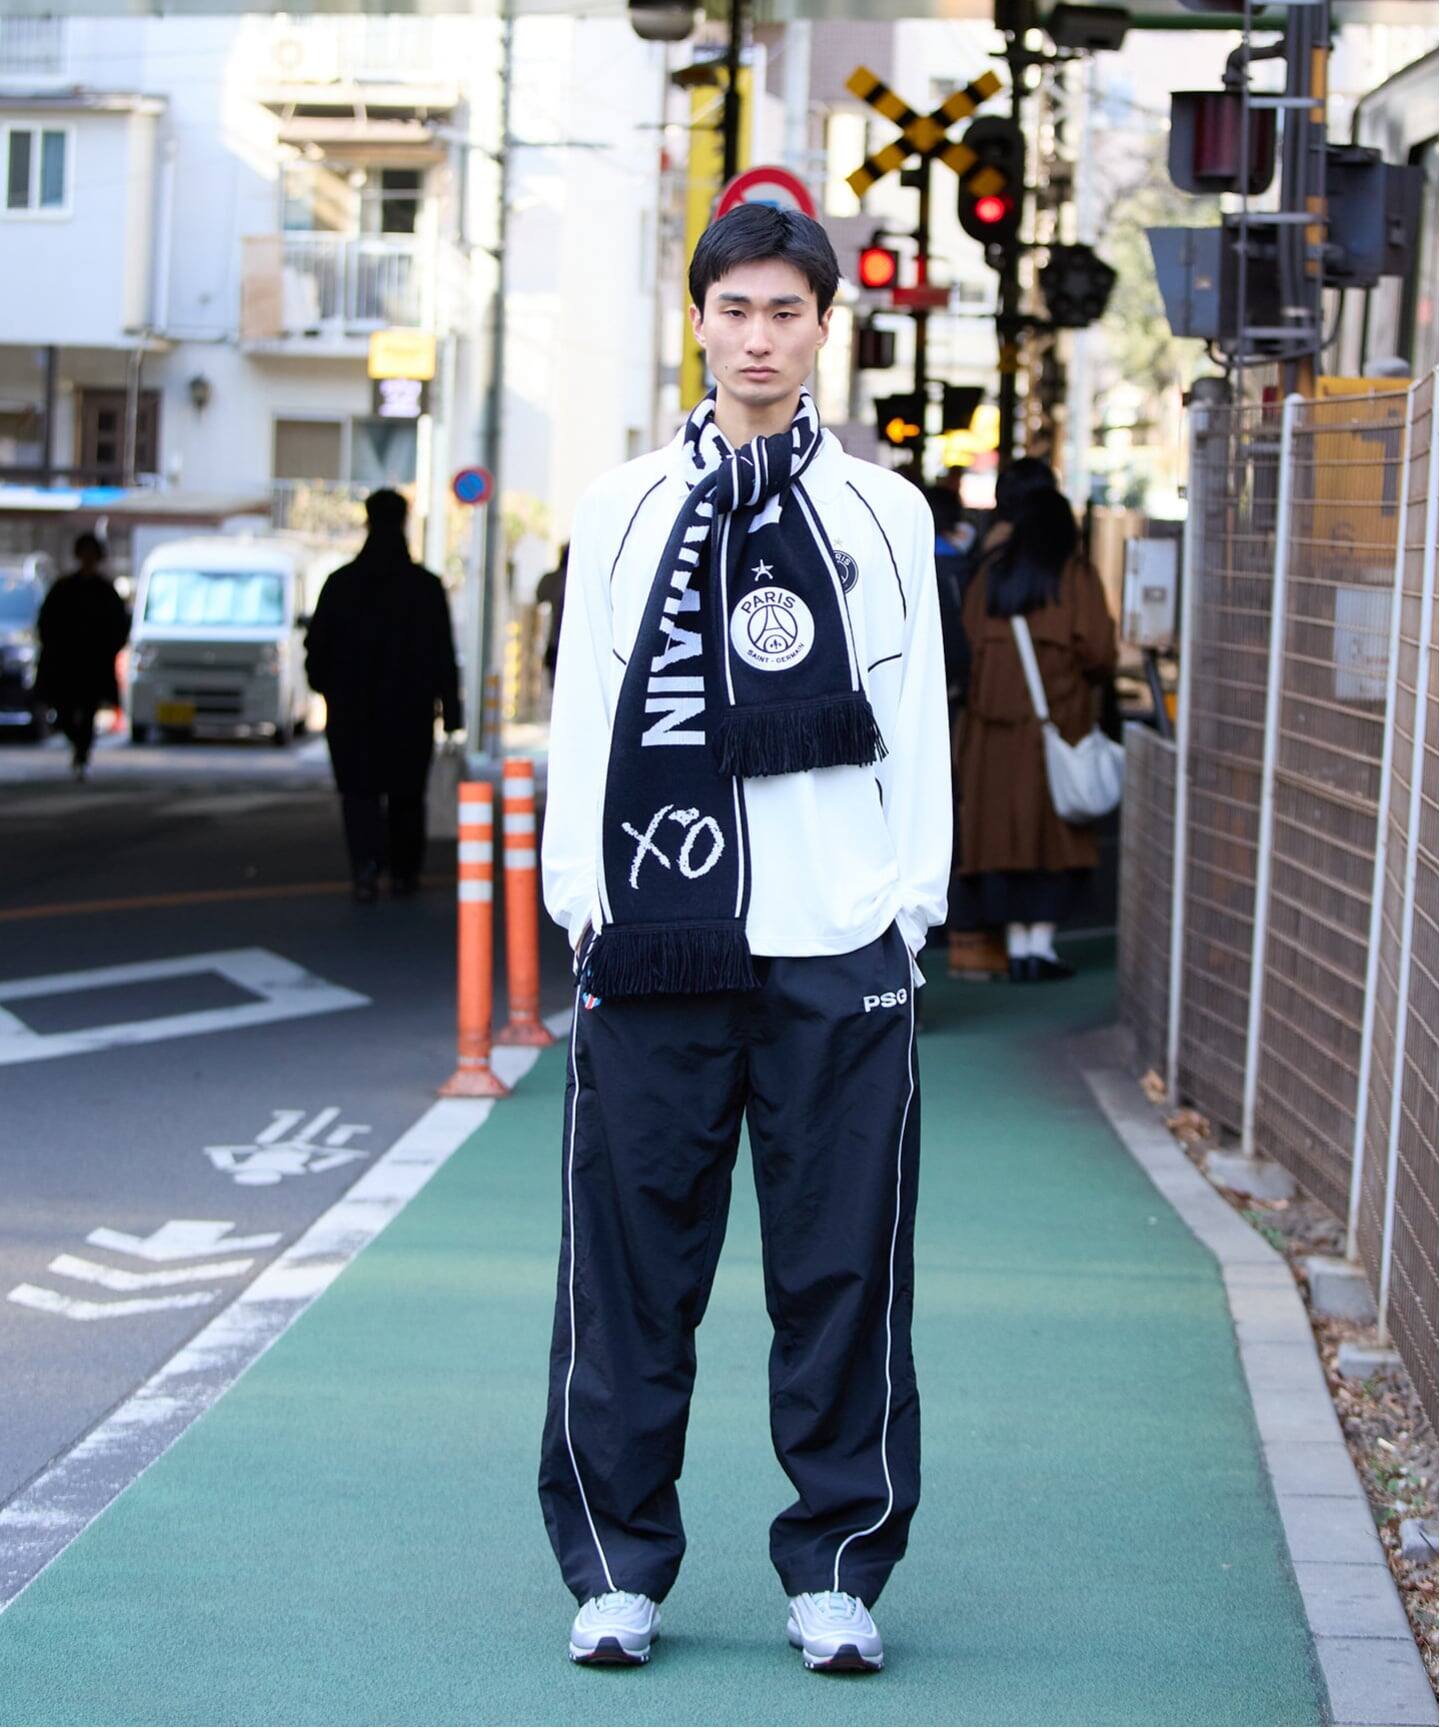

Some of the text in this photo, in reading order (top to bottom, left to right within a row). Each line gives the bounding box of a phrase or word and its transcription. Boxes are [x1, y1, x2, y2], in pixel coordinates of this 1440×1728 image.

[834, 553, 851, 566] RIS
[740, 591, 796, 614] PARIS
[621, 804, 725, 889] XO
[863, 988, 908, 1013] PSG
